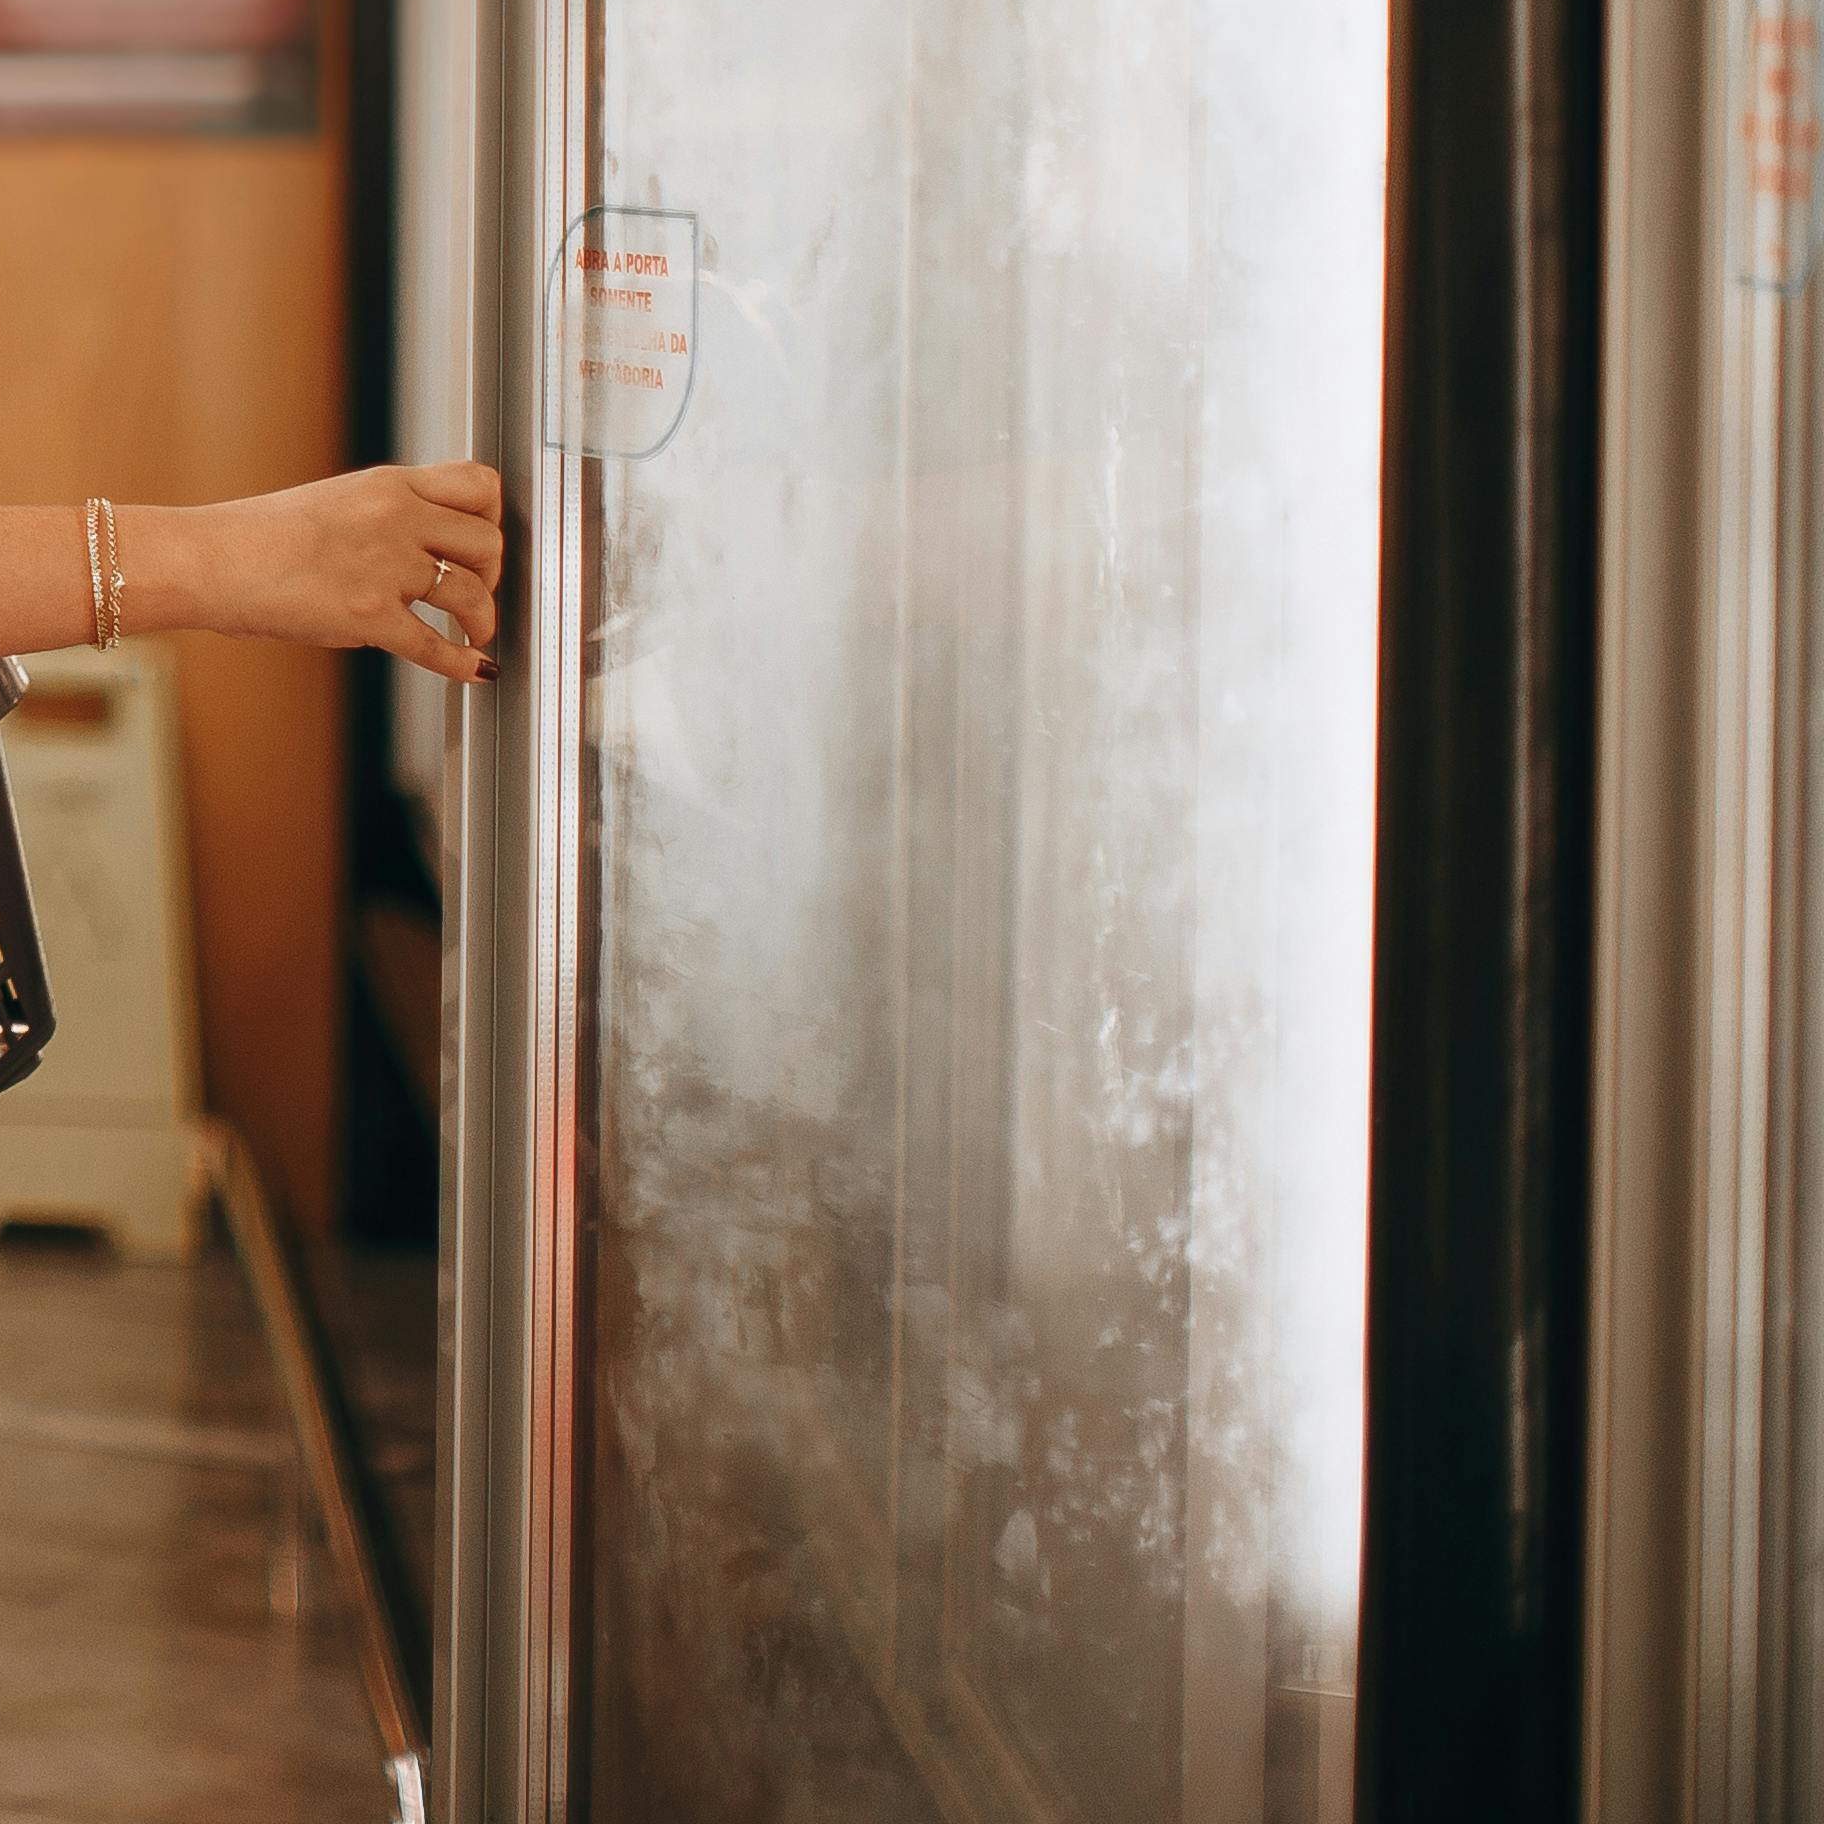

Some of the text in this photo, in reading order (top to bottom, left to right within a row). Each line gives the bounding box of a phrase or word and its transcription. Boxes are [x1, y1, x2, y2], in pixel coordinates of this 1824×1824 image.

[575, 247, 669, 277] ABRA A PORTA
[590, 286, 653, 312] SOMENTE
[670, 332, 688, 355] DA
